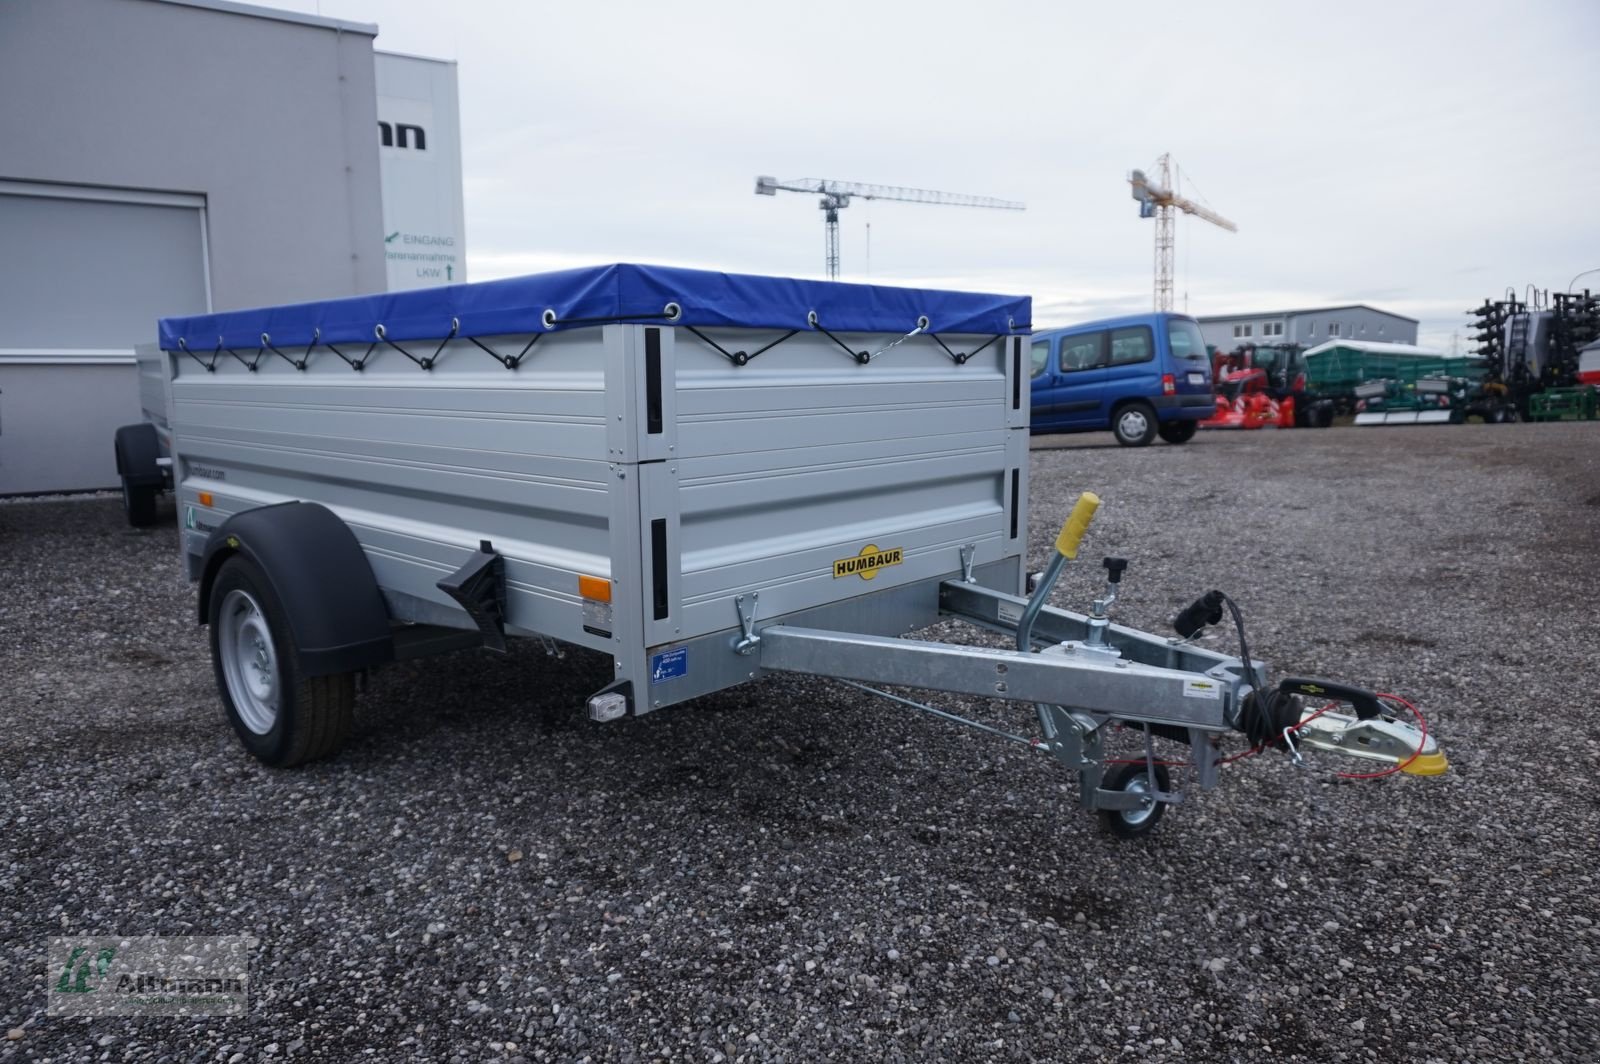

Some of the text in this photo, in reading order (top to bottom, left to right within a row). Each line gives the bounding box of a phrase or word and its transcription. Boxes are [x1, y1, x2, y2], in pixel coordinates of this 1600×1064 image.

[403, 234, 455, 246] EINGANG
[416, 268, 440, 277] LKW
[837, 551, 900, 574] HUMBAUR
